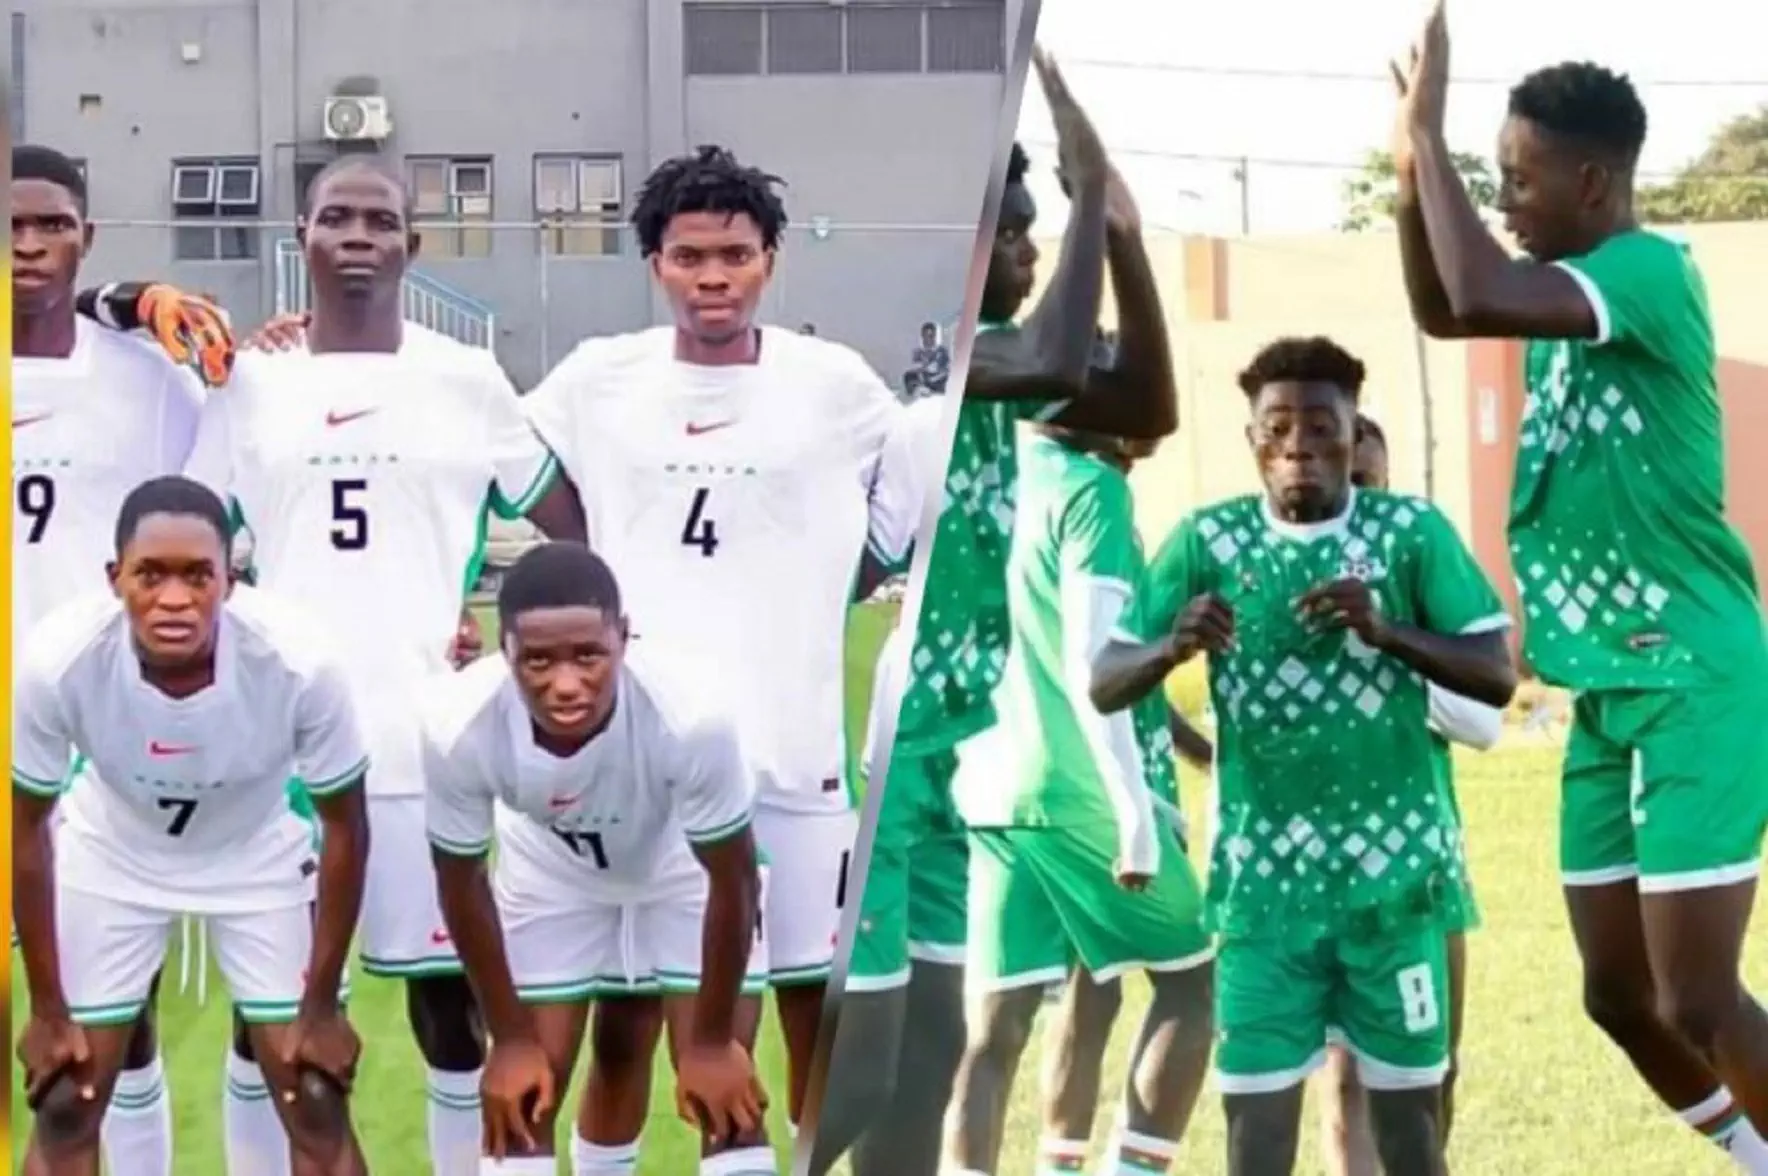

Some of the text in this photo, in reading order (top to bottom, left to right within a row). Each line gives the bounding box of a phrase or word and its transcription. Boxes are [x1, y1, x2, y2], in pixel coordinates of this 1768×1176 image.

[331, 479, 368, 550] 5
[681, 488, 719, 557] 4
[158, 797, 198, 837] 7
[1396, 962, 1439, 1033] 8
